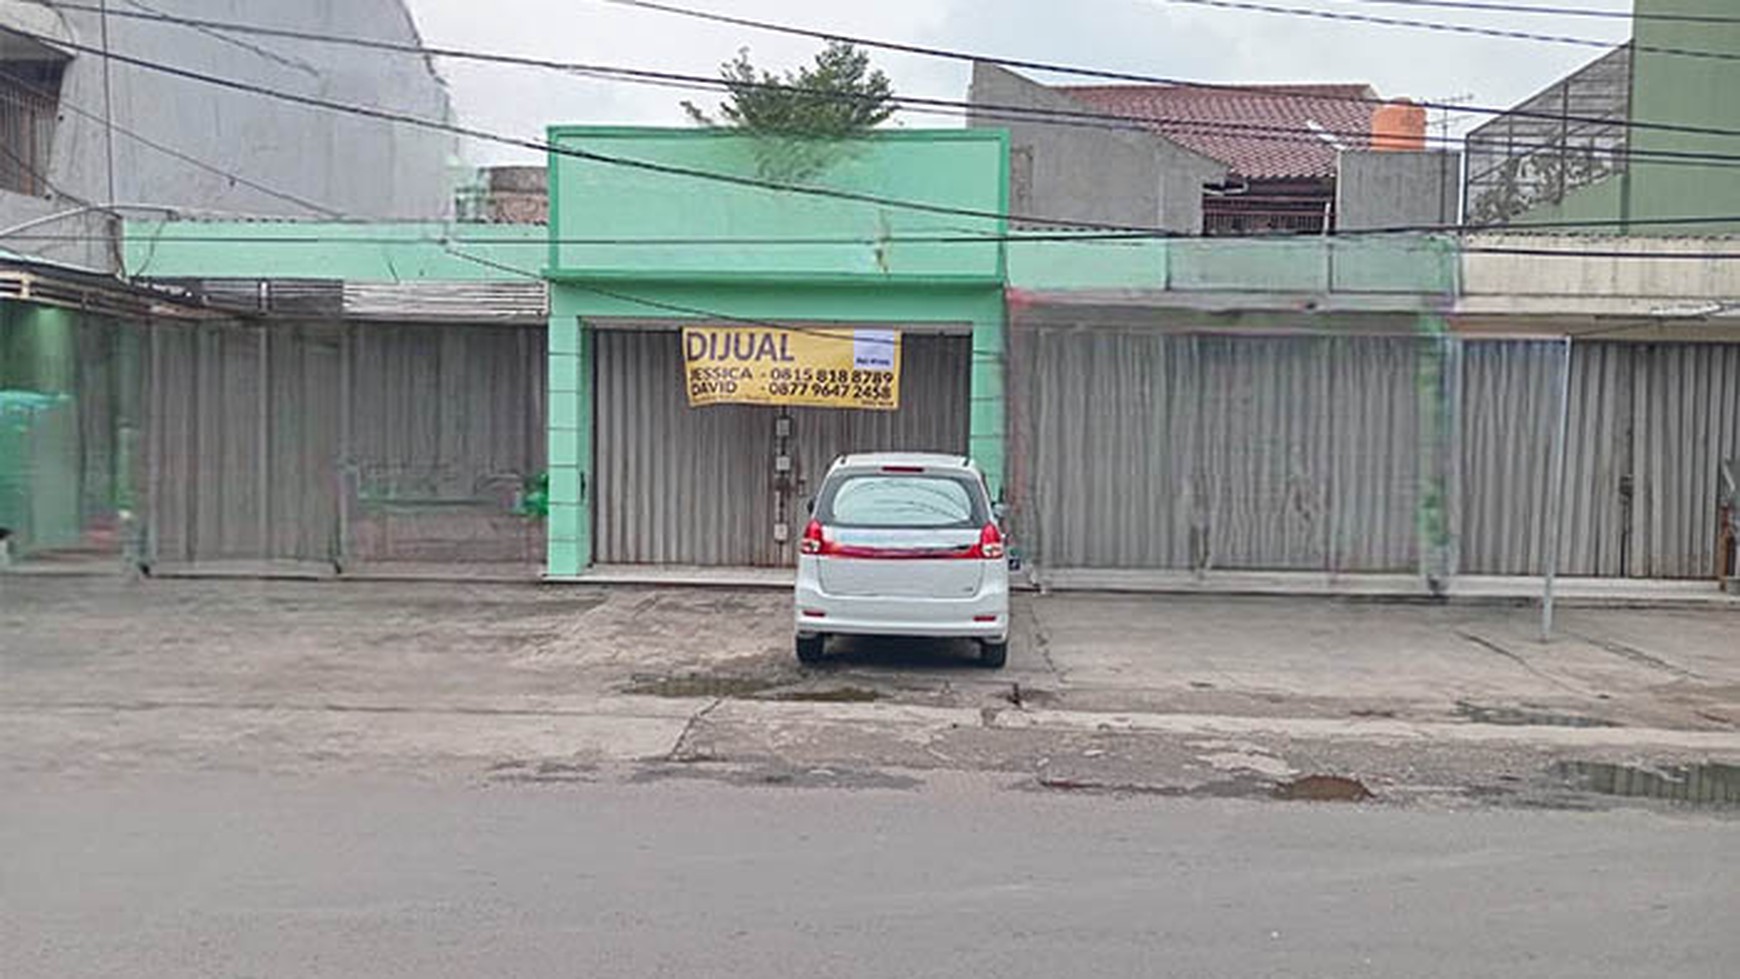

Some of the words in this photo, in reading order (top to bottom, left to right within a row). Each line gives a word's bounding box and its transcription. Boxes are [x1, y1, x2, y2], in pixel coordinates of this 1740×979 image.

[686, 332, 795, 362] DIJUAL
[690, 367, 753, 381] JESSICA
[770, 367, 813, 381] 0815
[816, 369, 849, 383] 818
[851, 370, 894, 385] 8789
[692, 381, 738, 396] DAVID
[768, 382, 809, 396] 0877
[811, 383, 850, 398] 9647
[853, 385, 892, 400] 2458
